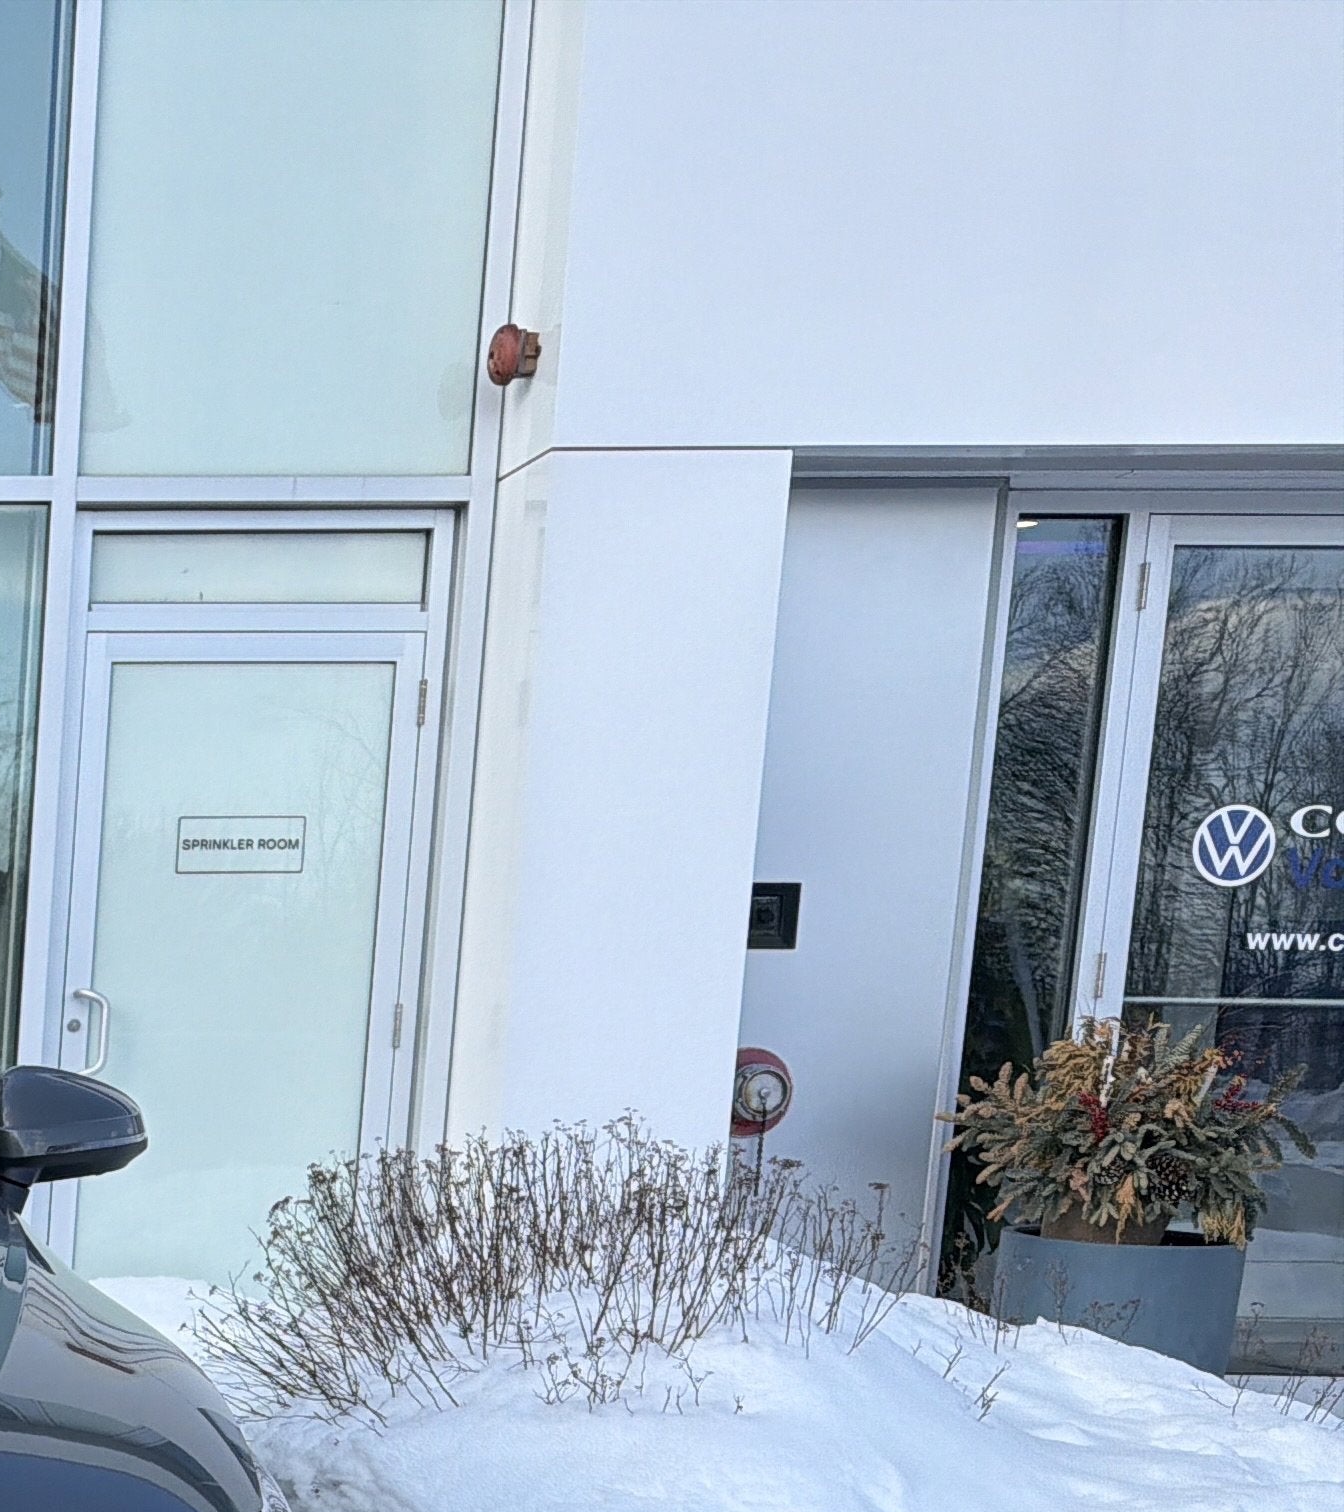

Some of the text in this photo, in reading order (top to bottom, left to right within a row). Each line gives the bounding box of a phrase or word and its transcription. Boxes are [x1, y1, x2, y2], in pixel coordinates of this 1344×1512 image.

[1290, 804, 1344, 838] C
[182, 838, 300, 850] SPRINKLER ROOM
